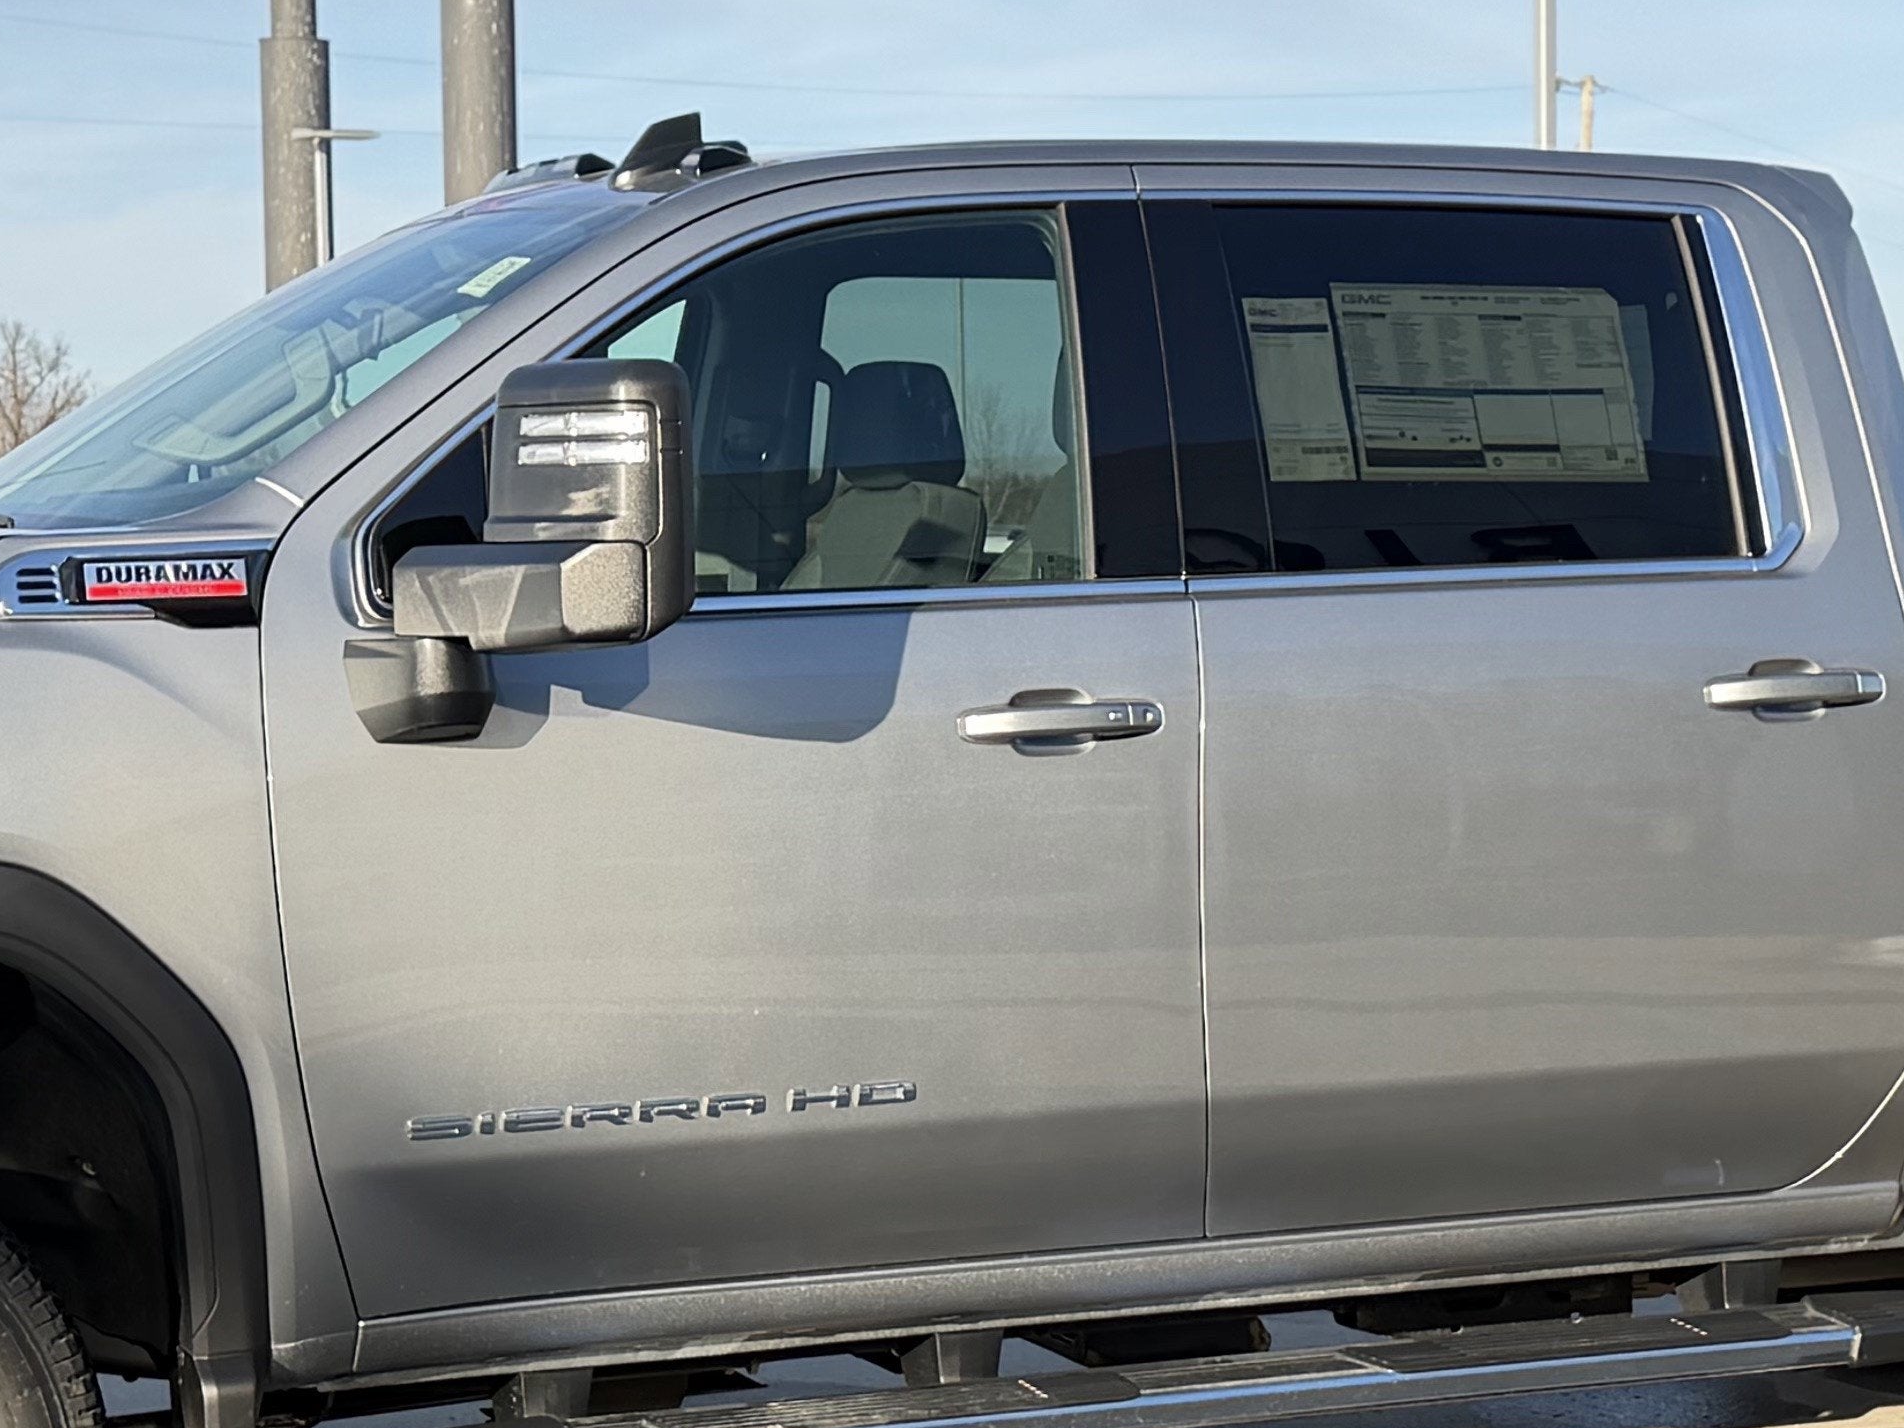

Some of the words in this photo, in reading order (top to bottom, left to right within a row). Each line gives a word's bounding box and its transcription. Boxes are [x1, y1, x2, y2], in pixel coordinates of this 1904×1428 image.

[1341, 294, 1392, 305] GMC
[96, 562, 236, 584] DURAMAX
[405, 1091, 768, 1141] SIERRA
[786, 1079, 918, 1113] HD
